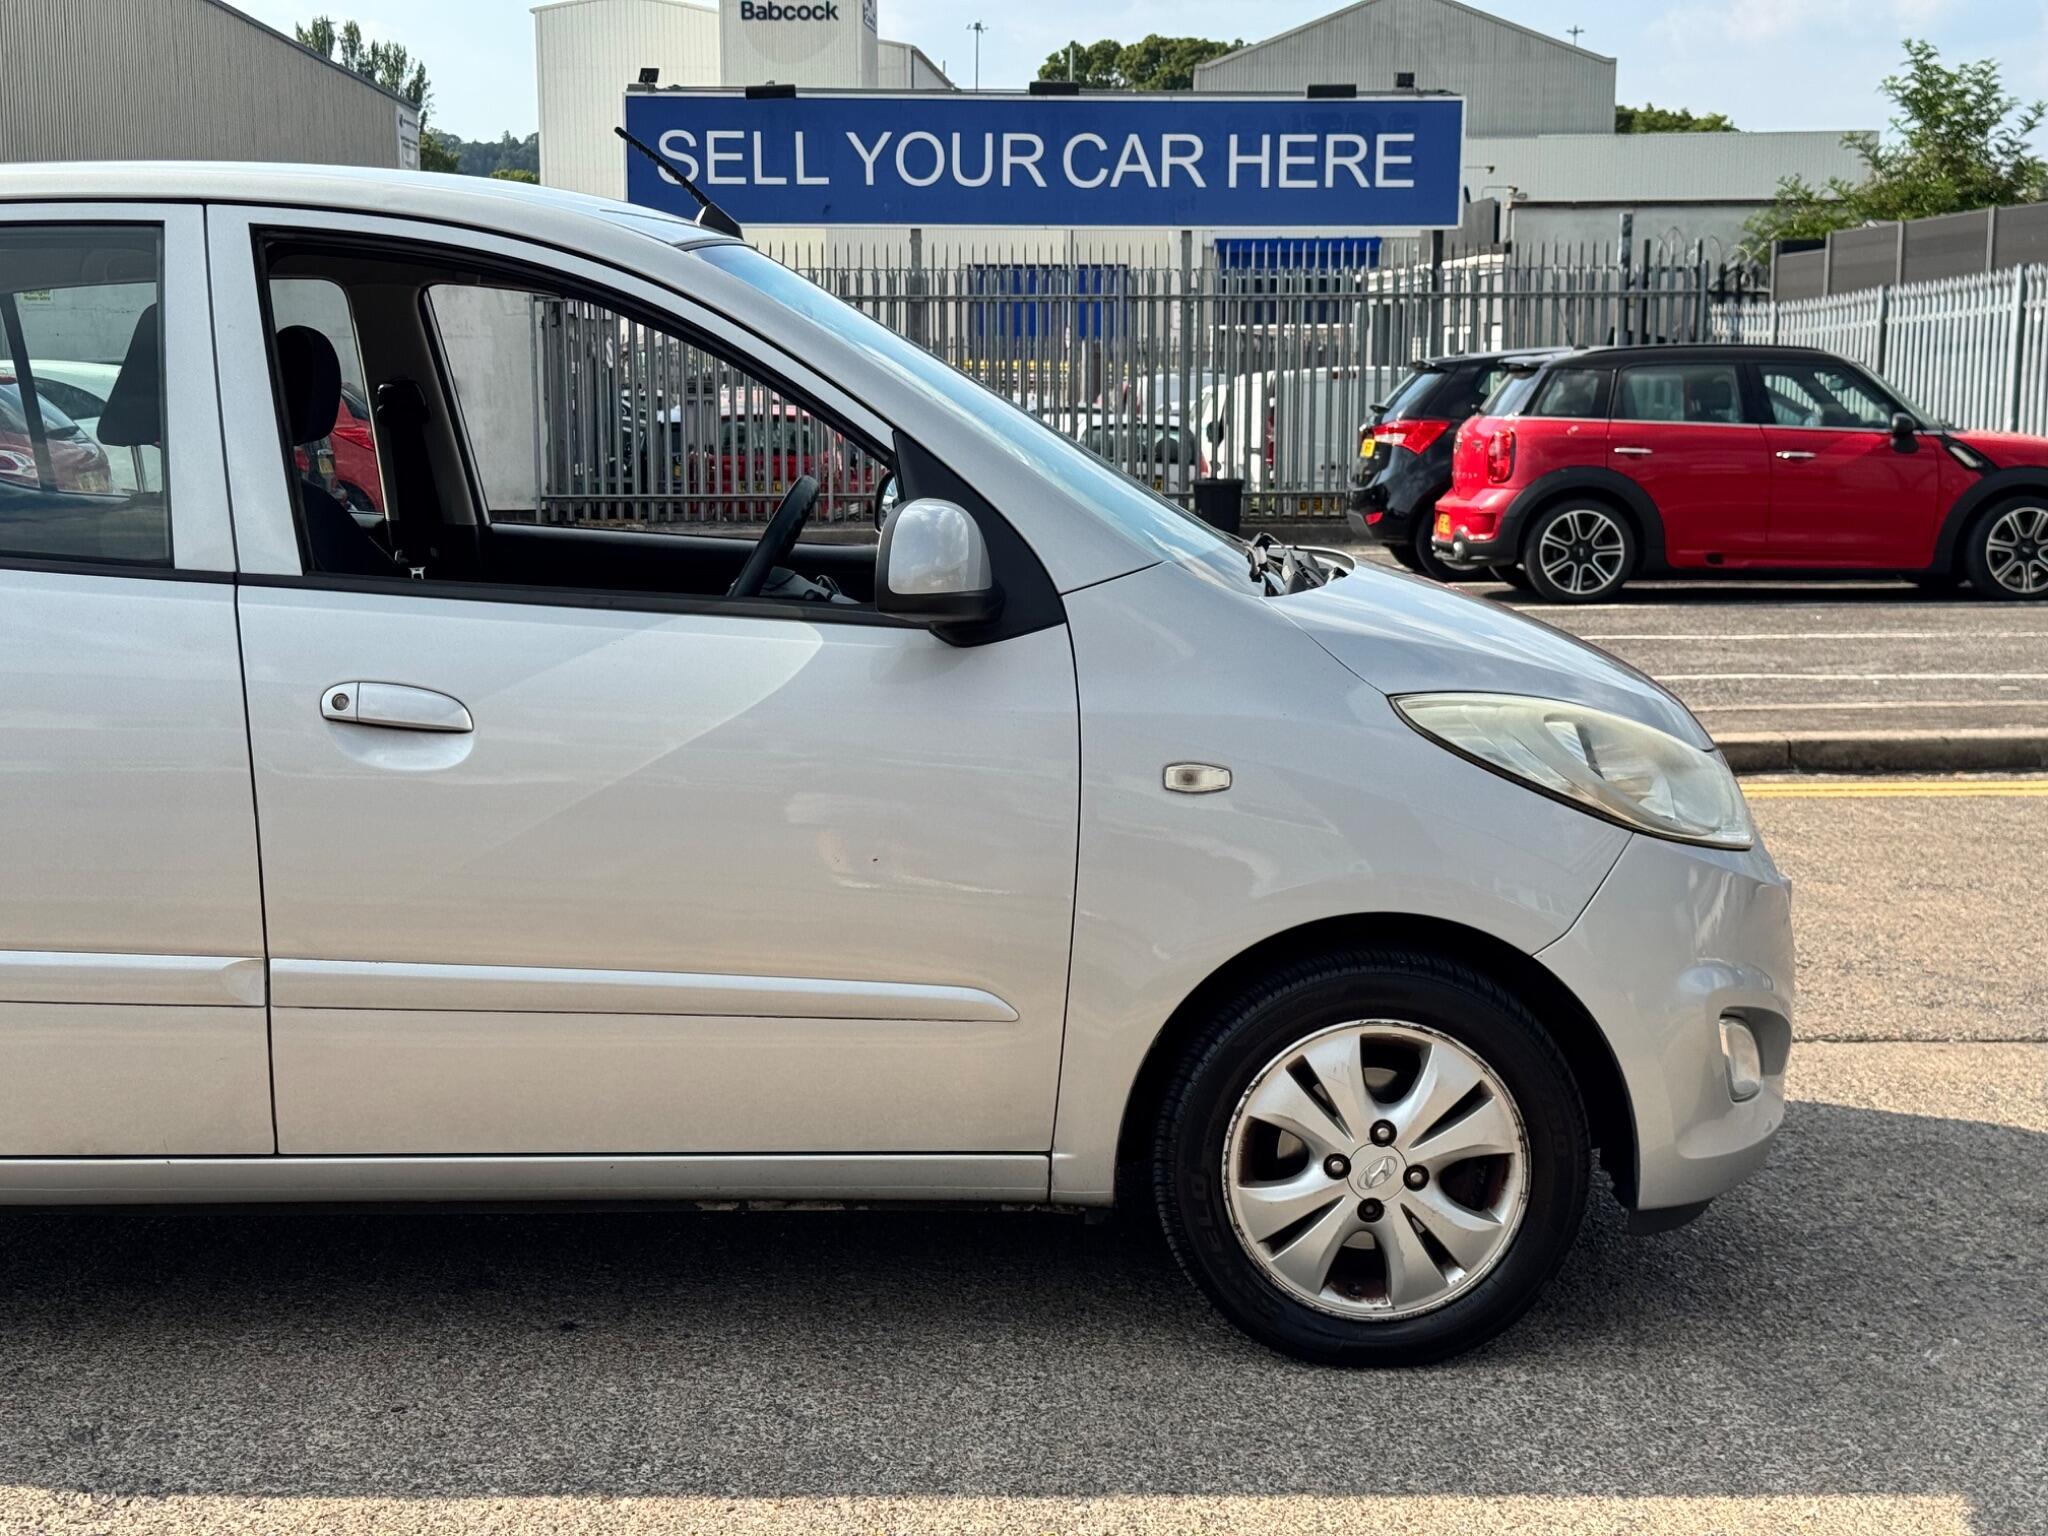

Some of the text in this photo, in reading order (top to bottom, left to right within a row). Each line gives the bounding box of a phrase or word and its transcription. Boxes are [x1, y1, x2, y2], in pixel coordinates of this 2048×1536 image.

[740, 1, 839, 21] Babcock
[656, 129, 1415, 189] SELL YOUR CAR HERE
